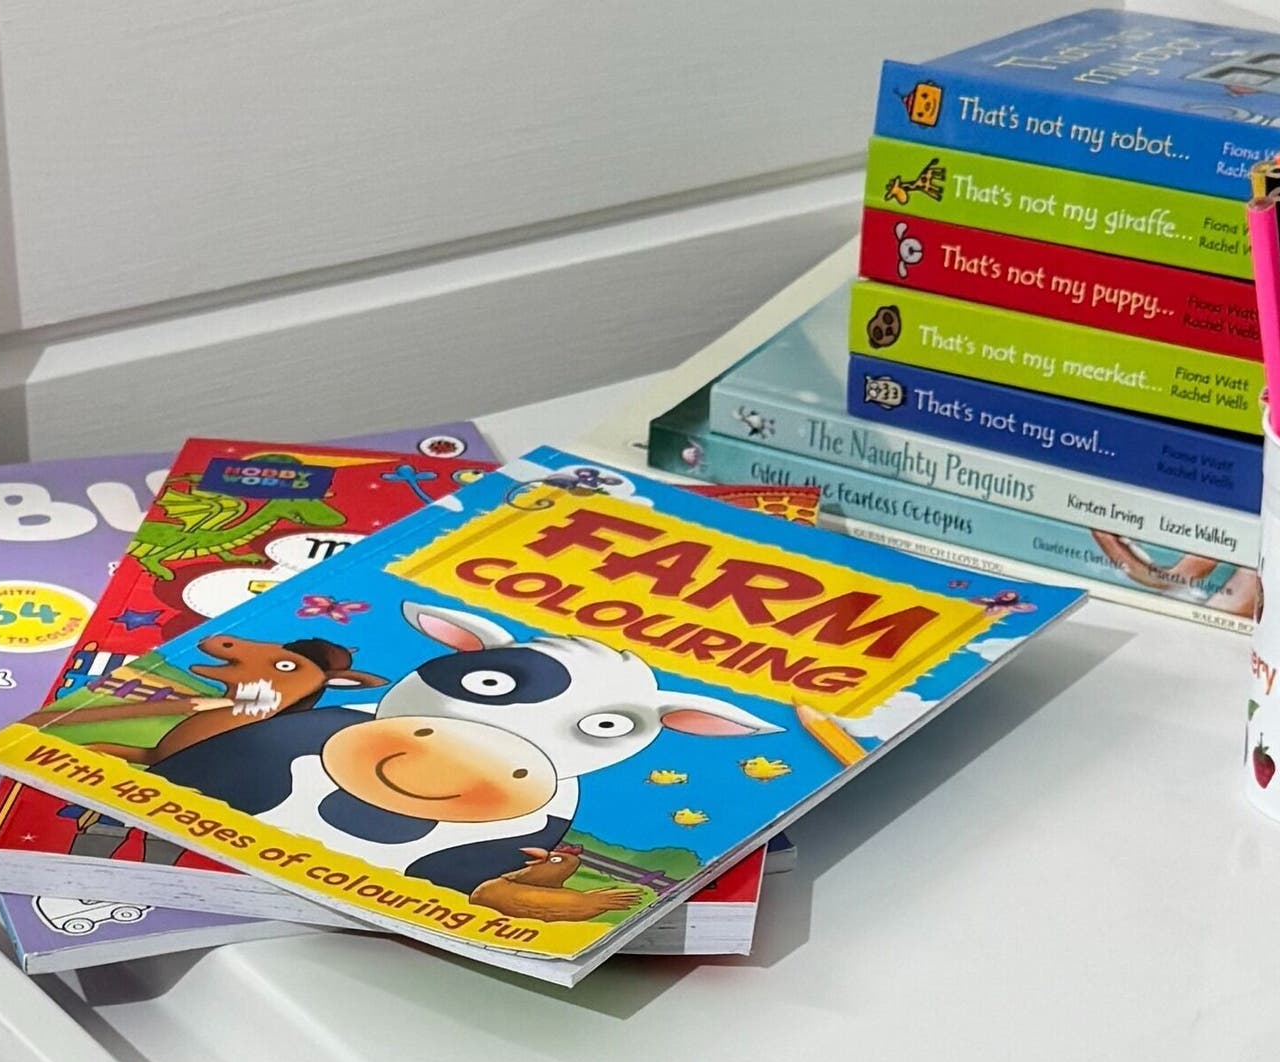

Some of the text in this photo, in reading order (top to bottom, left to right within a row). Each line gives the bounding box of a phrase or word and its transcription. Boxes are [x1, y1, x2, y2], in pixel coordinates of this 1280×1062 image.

[959, 96, 1190, 160] That's not my robot...
[1222, 142, 1260, 160] Fiona
[1216, 161, 1252, 178] Rach
[953, 174, 1193, 240] That's not my giraffe...
[1203, 217, 1238, 234] Fiona
[1198, 236, 1239, 255] Rachel
[941, 244, 1175, 319] That's not my puppy...
[919, 325, 1163, 393] That's not my meerkat...
[1175, 366, 1249, 392] Fiona Watt
[914, 388, 1116, 457] That's not my owl...
[1170, 385, 1249, 411] Rachel Wells
[224, 467, 313, 481] HOBBY
[807, 419, 1035, 502] The Naughty Penguins
[837, 482, 898, 515] Fearless
[902, 503, 973, 535] Octopus
[1067, 494, 1238, 552] Kirsten Irving Lizzie Walkley
[523, 508, 940, 659] FARM
[7, 636, 30, 644] TO
[455, 558, 867, 693] COLOURING
[1192, 611, 1237, 629] WALKER
[1251, 650, 1276, 696] ery
[24, 745, 540, 943] With 48 pages of colouring fun
